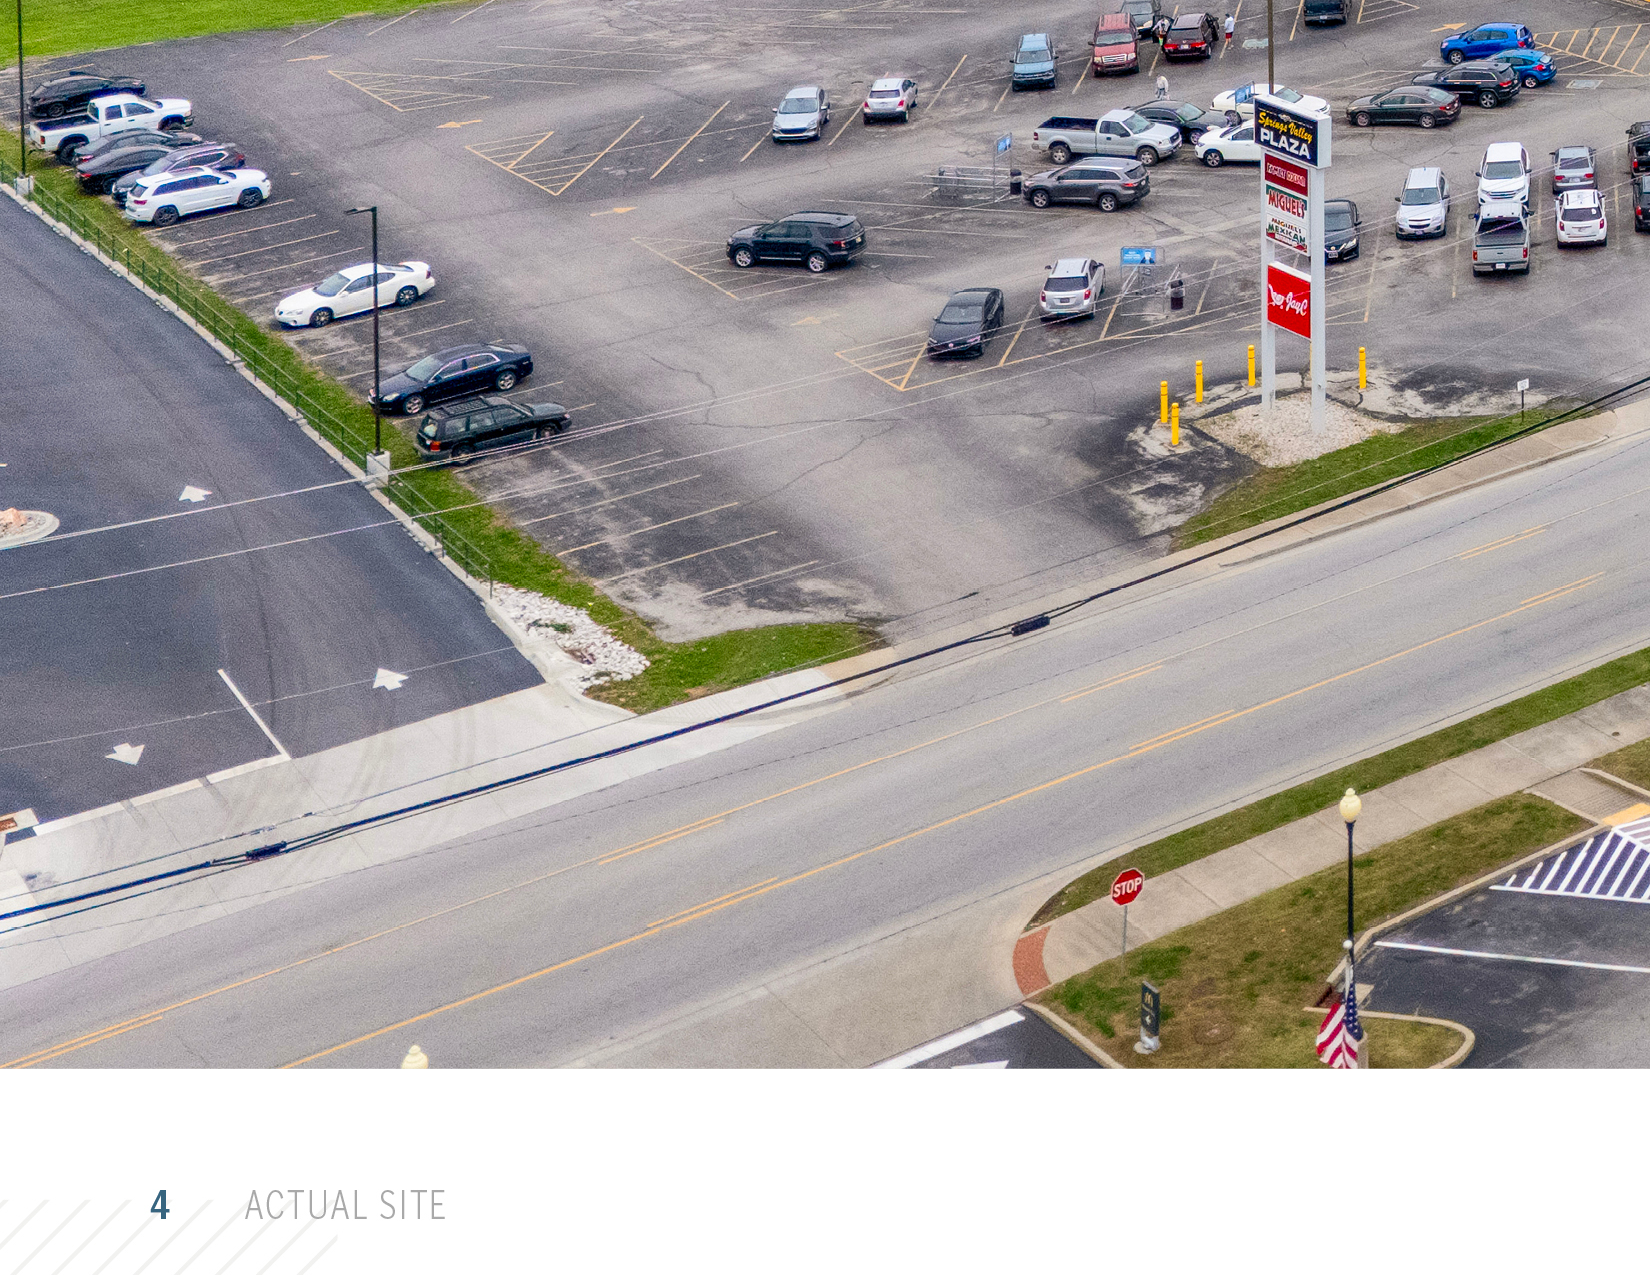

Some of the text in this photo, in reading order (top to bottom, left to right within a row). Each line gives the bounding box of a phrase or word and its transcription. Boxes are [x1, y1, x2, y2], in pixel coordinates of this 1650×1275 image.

[1258, 112, 1288, 134] Springs
[1288, 122, 1313, 144] Valley
[1260, 127, 1311, 160] PLAZA
[1267, 223, 1306, 244] MEXICAN
[1285, 291, 1308, 316] JayC
[1113, 877, 1142, 898] STOP
